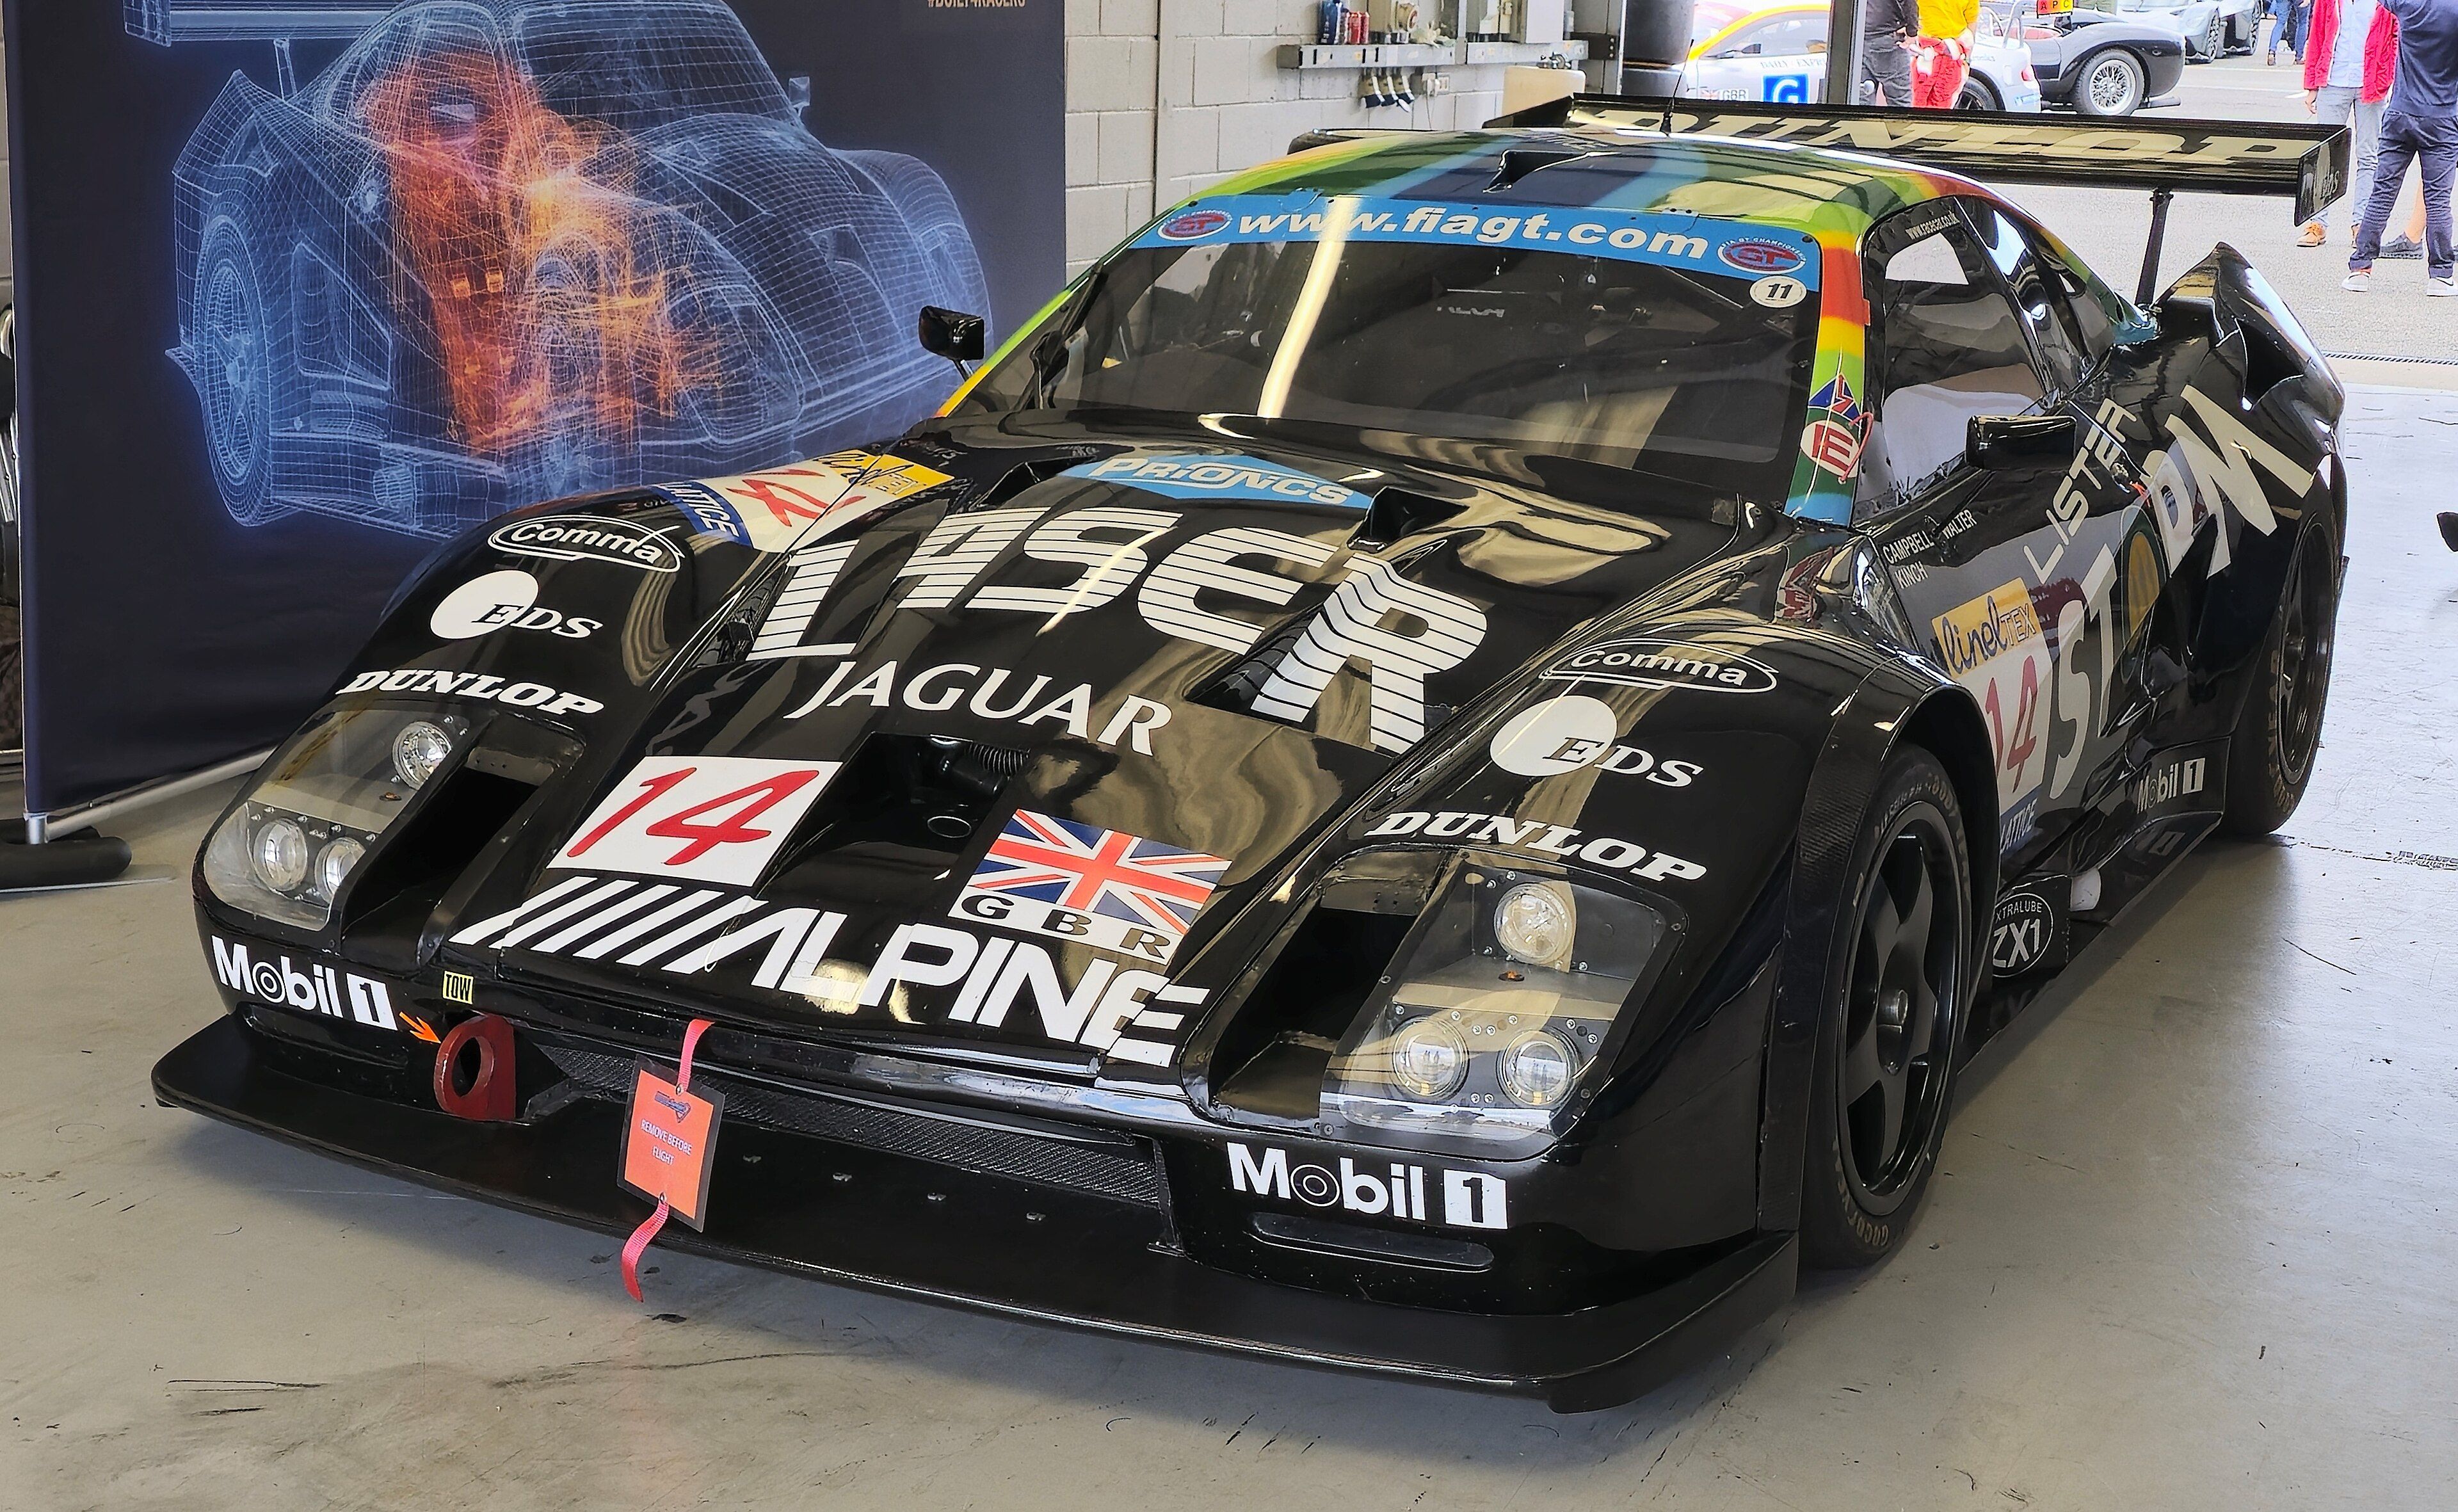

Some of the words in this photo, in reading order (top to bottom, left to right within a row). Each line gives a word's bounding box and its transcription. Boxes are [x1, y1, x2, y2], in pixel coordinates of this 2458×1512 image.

[1722, 90, 1747, 101] GBR
[1238, 202, 1708, 260] www.fiagt.com
[1768, 283, 1793, 299] 11
[2023, 398, 2137, 584] LISTER
[510, 522, 663, 565] Comma
[1883, 530, 1934, 564] CAMPBELL
[1938, 509, 1977, 540] WALTER
[1895, 560, 1929, 589] KINCH
[472, 604, 603, 639] EDS
[746, 507, 1488, 757] LASER
[335, 669, 605, 715] DUNLOP
[1571, 648, 1748, 686] Comma
[784, 661, 1172, 755] JAGUAR
[1543, 736, 1704, 789] EDS
[566, 759, 839, 865] 14
[2137, 763, 2179, 814] Mobil
[1364, 811, 1707, 882] DUNLOP
[1993, 919, 2040, 968] ZX1
[213, 935, 343, 1021] Mobil
[446, 974, 471, 1001] TOW
[661, 907, 1210, 1068] ALPINE
[641, 1118, 668, 1143] REMOVE
[667, 1132, 693, 1156] BEFORE
[652, 1145, 675, 1166] FLIGHT
[1226, 1141, 1426, 1221] Mobil
